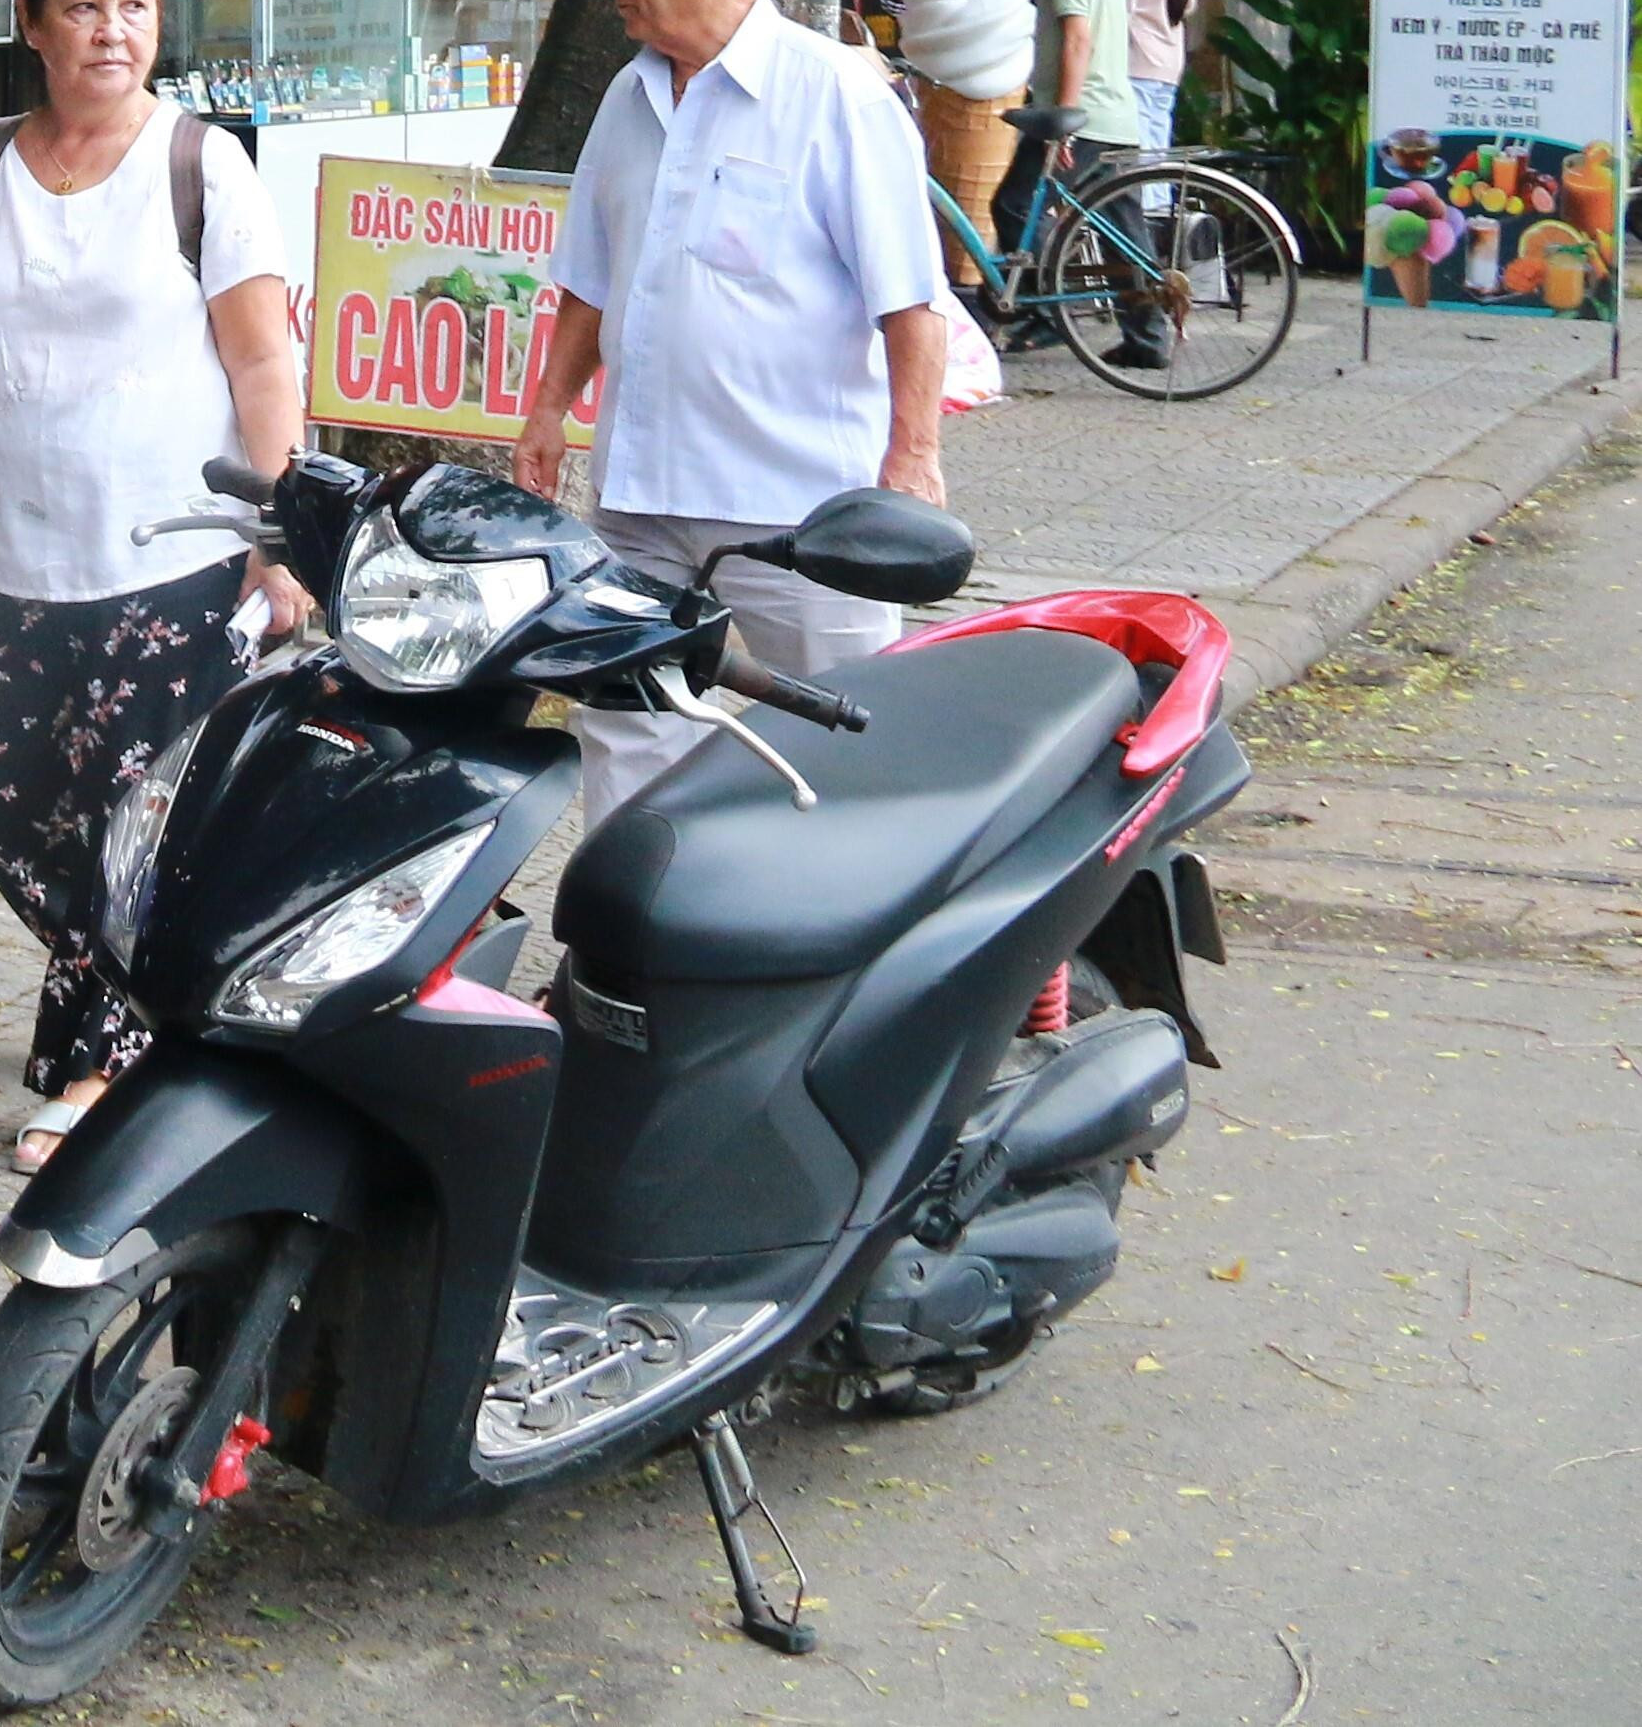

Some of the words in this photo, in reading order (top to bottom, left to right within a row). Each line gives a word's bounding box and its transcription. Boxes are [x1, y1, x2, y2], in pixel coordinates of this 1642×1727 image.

[349, 185, 415, 250] ĐẶC
[423, 187, 491, 250] SẢN
[499, 200, 556, 264] HỘI
[336, 291, 464, 411] CAO
[296, 723, 356, 752] HONDA
